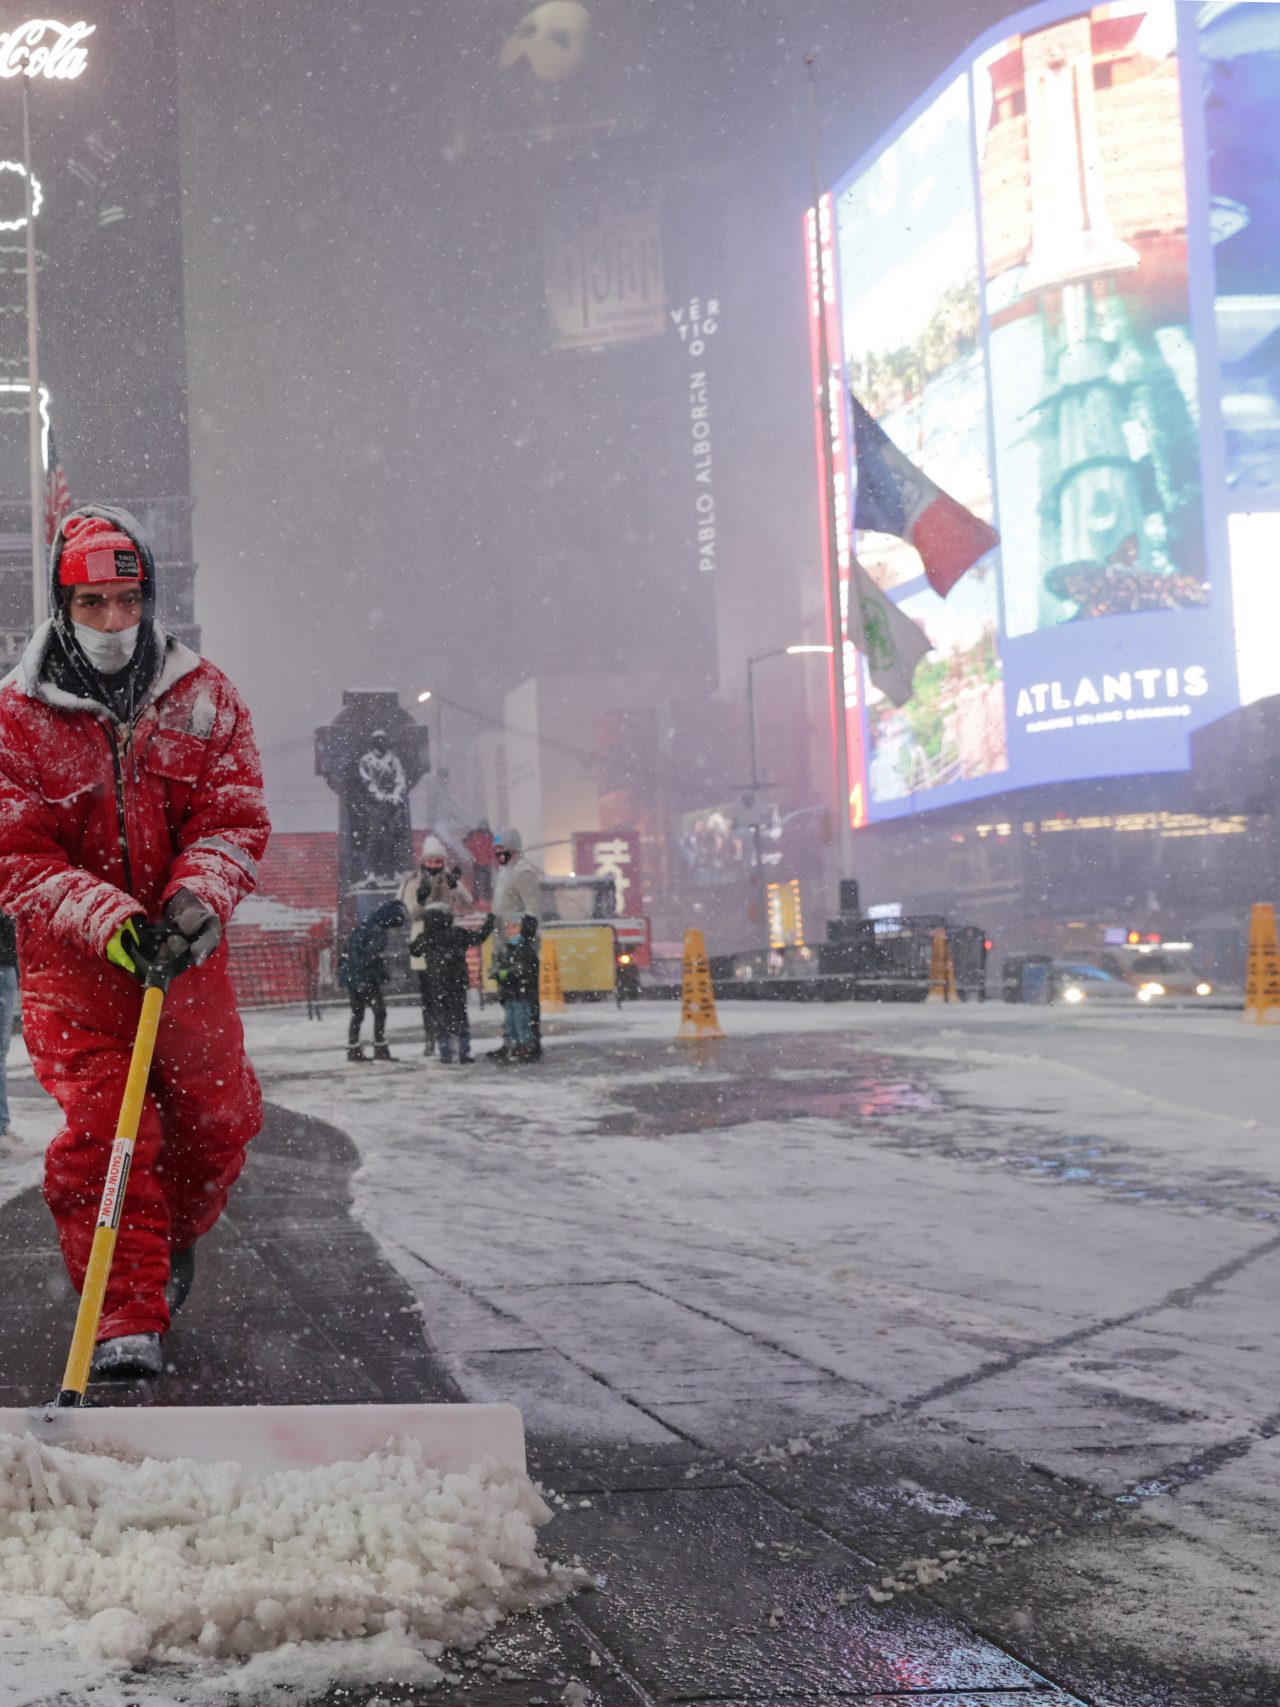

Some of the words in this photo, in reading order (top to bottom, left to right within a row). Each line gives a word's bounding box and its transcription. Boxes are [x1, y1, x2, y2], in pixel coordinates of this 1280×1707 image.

[696, 494, 716, 572] PABLO
[1016, 666, 1208, 717] ATLANTIS
[112, 1141, 121, 1152] THE
[108, 1155, 122, 1185] SNOW
[102, 1187, 116, 1217] PLOW
